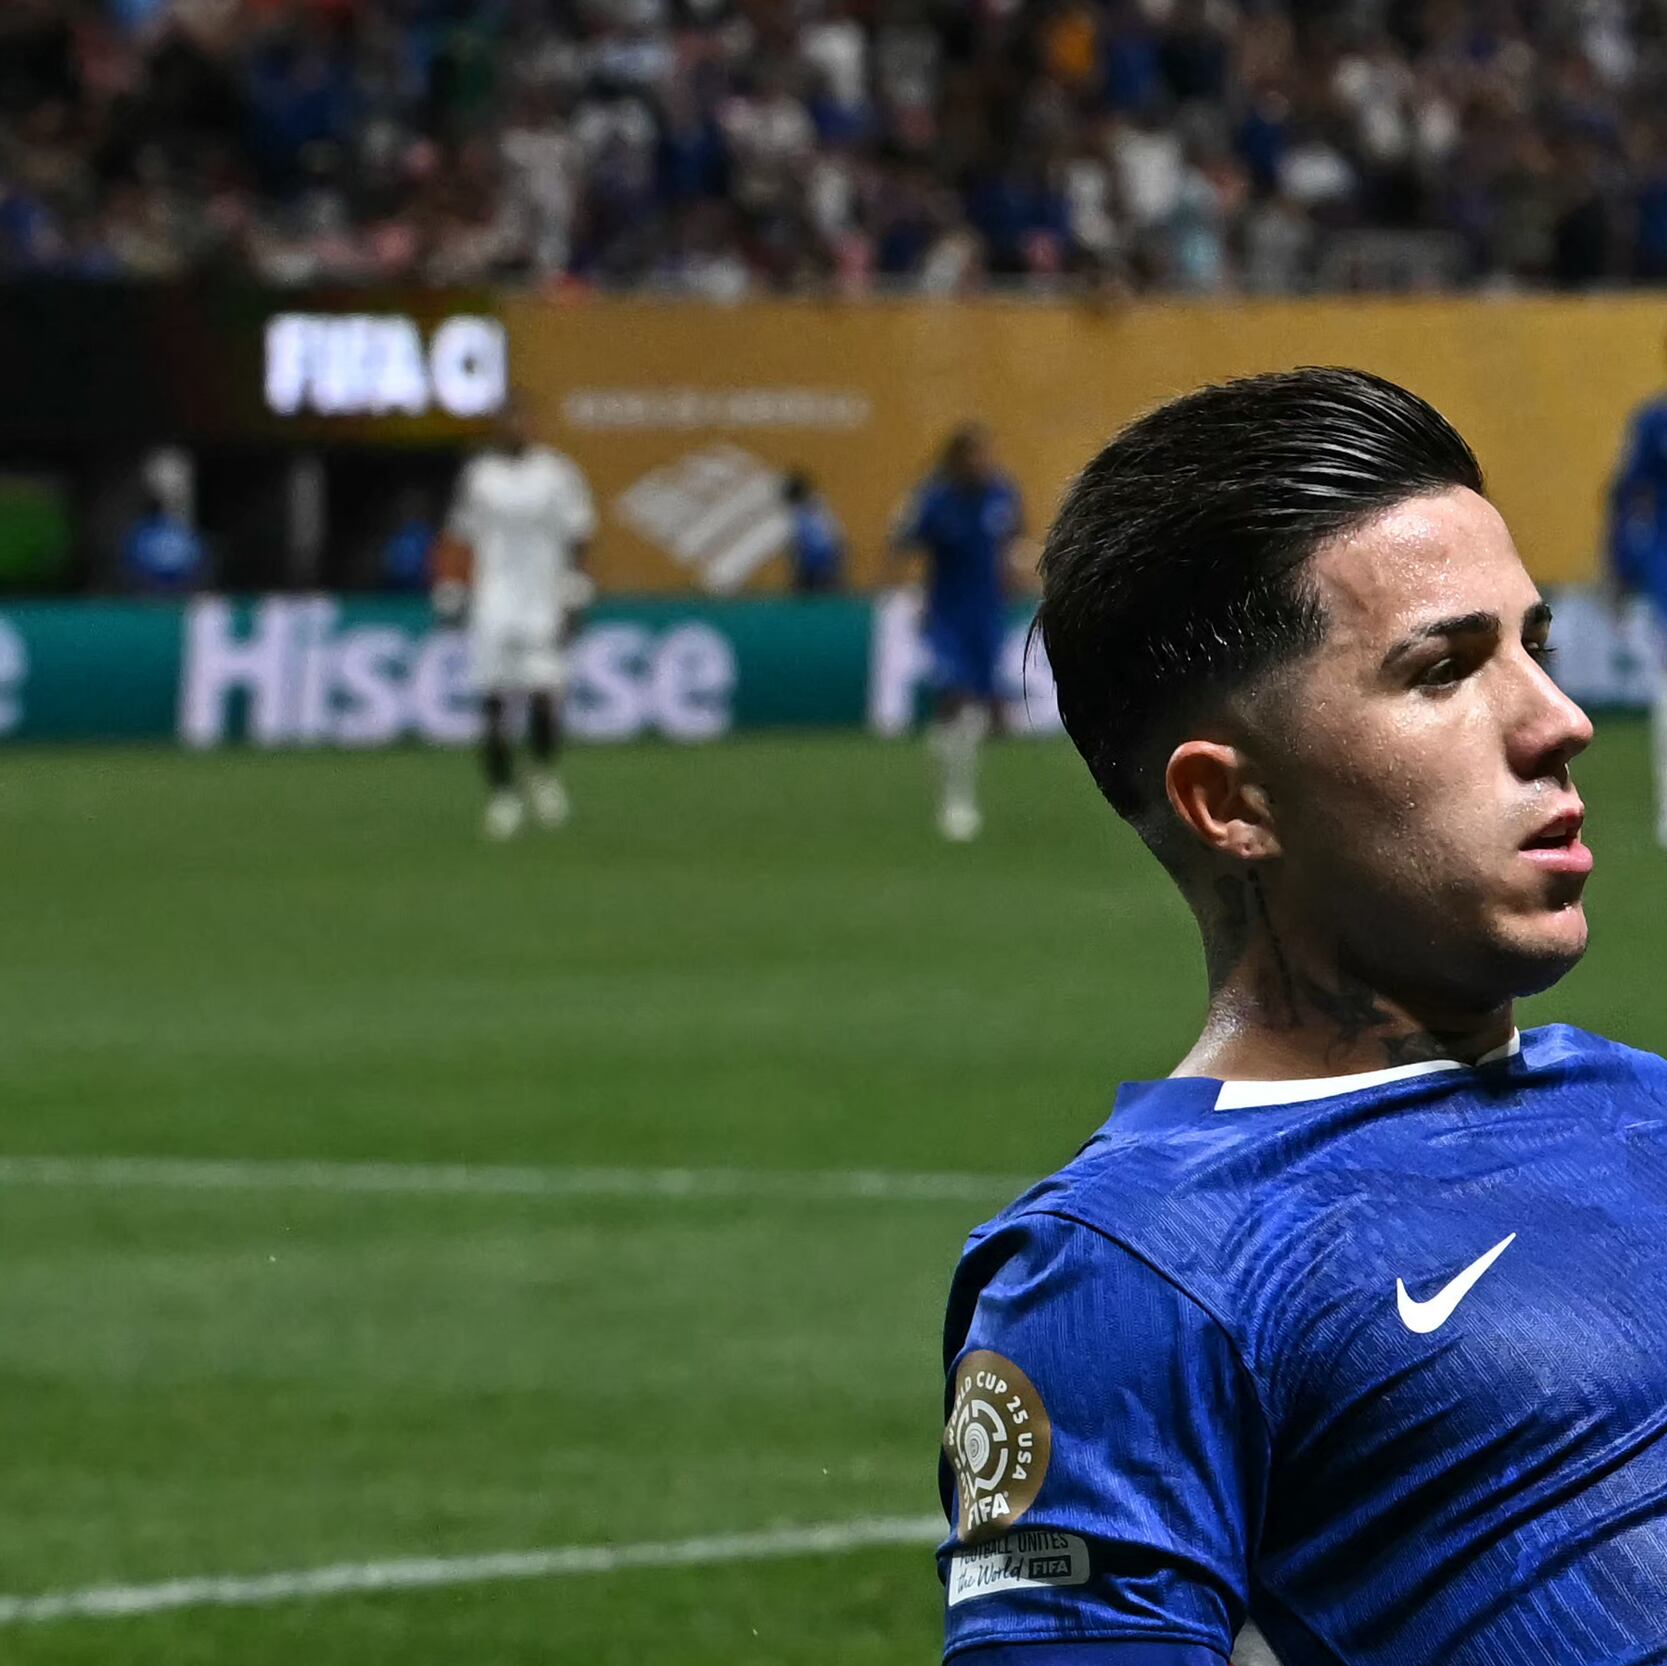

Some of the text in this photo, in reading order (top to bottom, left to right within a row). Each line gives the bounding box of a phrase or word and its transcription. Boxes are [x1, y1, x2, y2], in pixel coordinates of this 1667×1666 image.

[264, 314, 429, 417] FIFA
[180, 594, 738, 747] Hisese
[976, 1371, 1008, 1394] CUP
[1006, 1396, 1029, 1424] 25
[1012, 1432, 1033, 1480] USA
[968, 1493, 1011, 1530] FIFA
[1018, 1531, 1069, 1553] UNITES
[957, 1556, 1025, 1594] the World
[1032, 1559, 1069, 1576] FIFA
